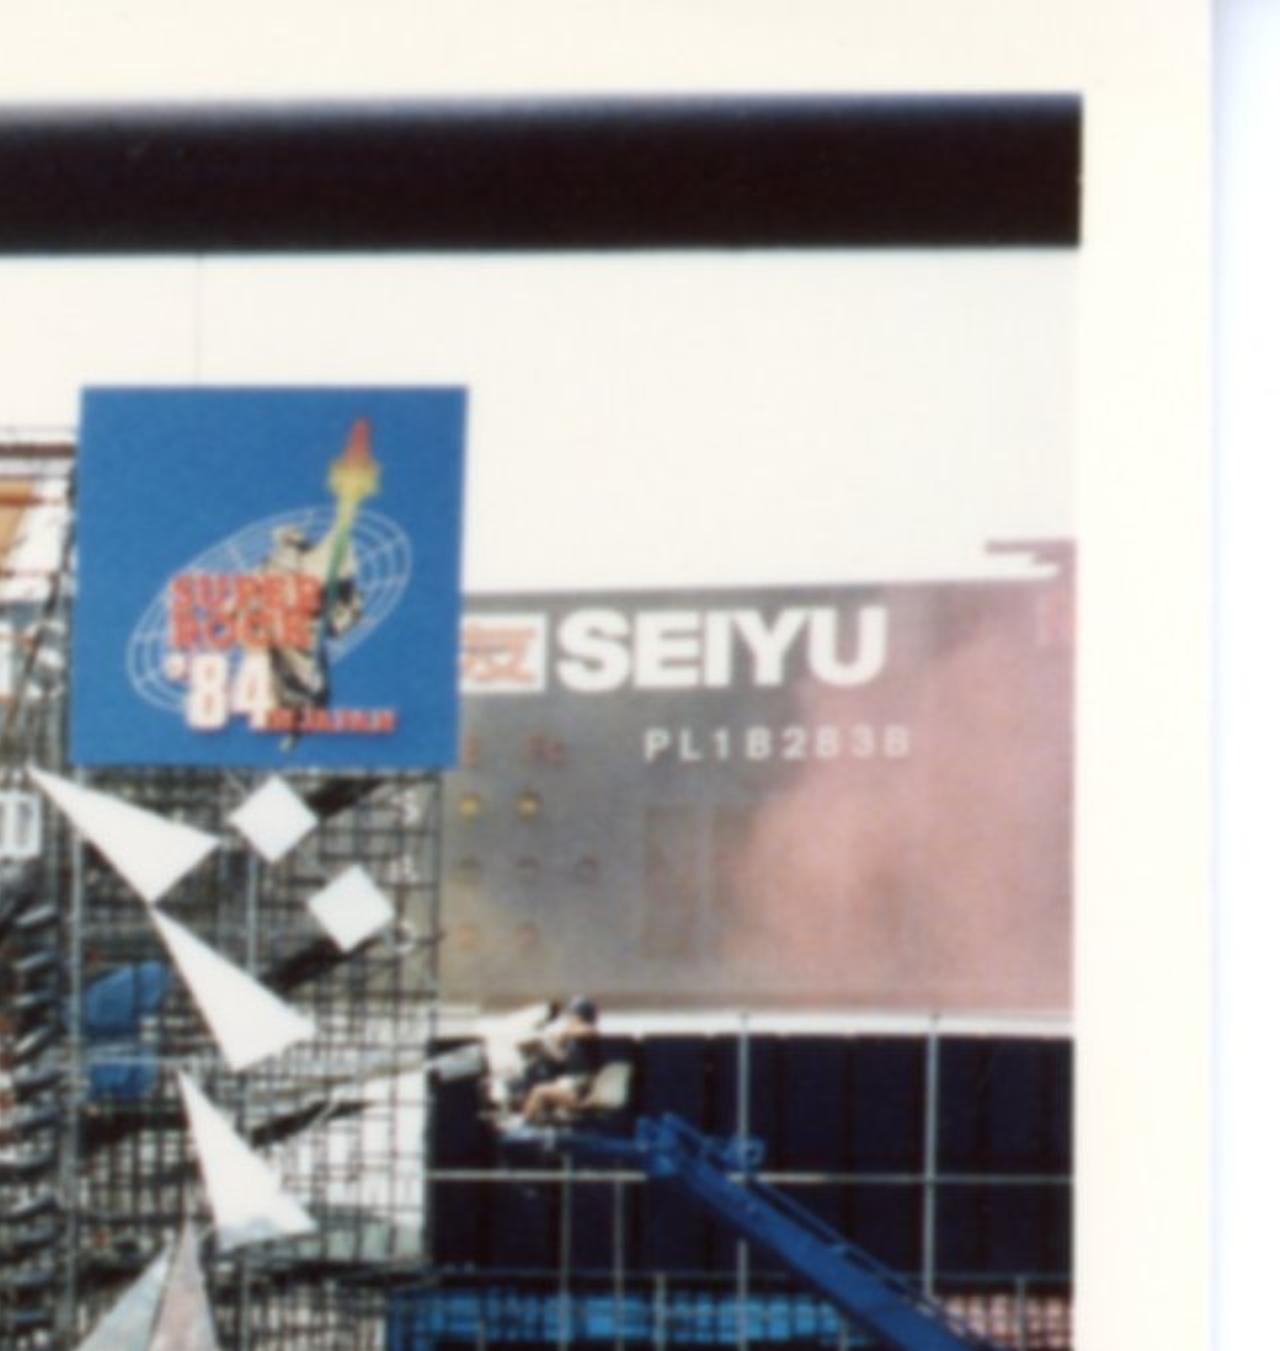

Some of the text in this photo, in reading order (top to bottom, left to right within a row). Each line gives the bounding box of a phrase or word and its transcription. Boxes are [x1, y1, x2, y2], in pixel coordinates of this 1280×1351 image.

[166, 608, 316, 652] ROCK
[556, 608, 888, 692] SEIYU
[164, 650, 278, 731] '84
